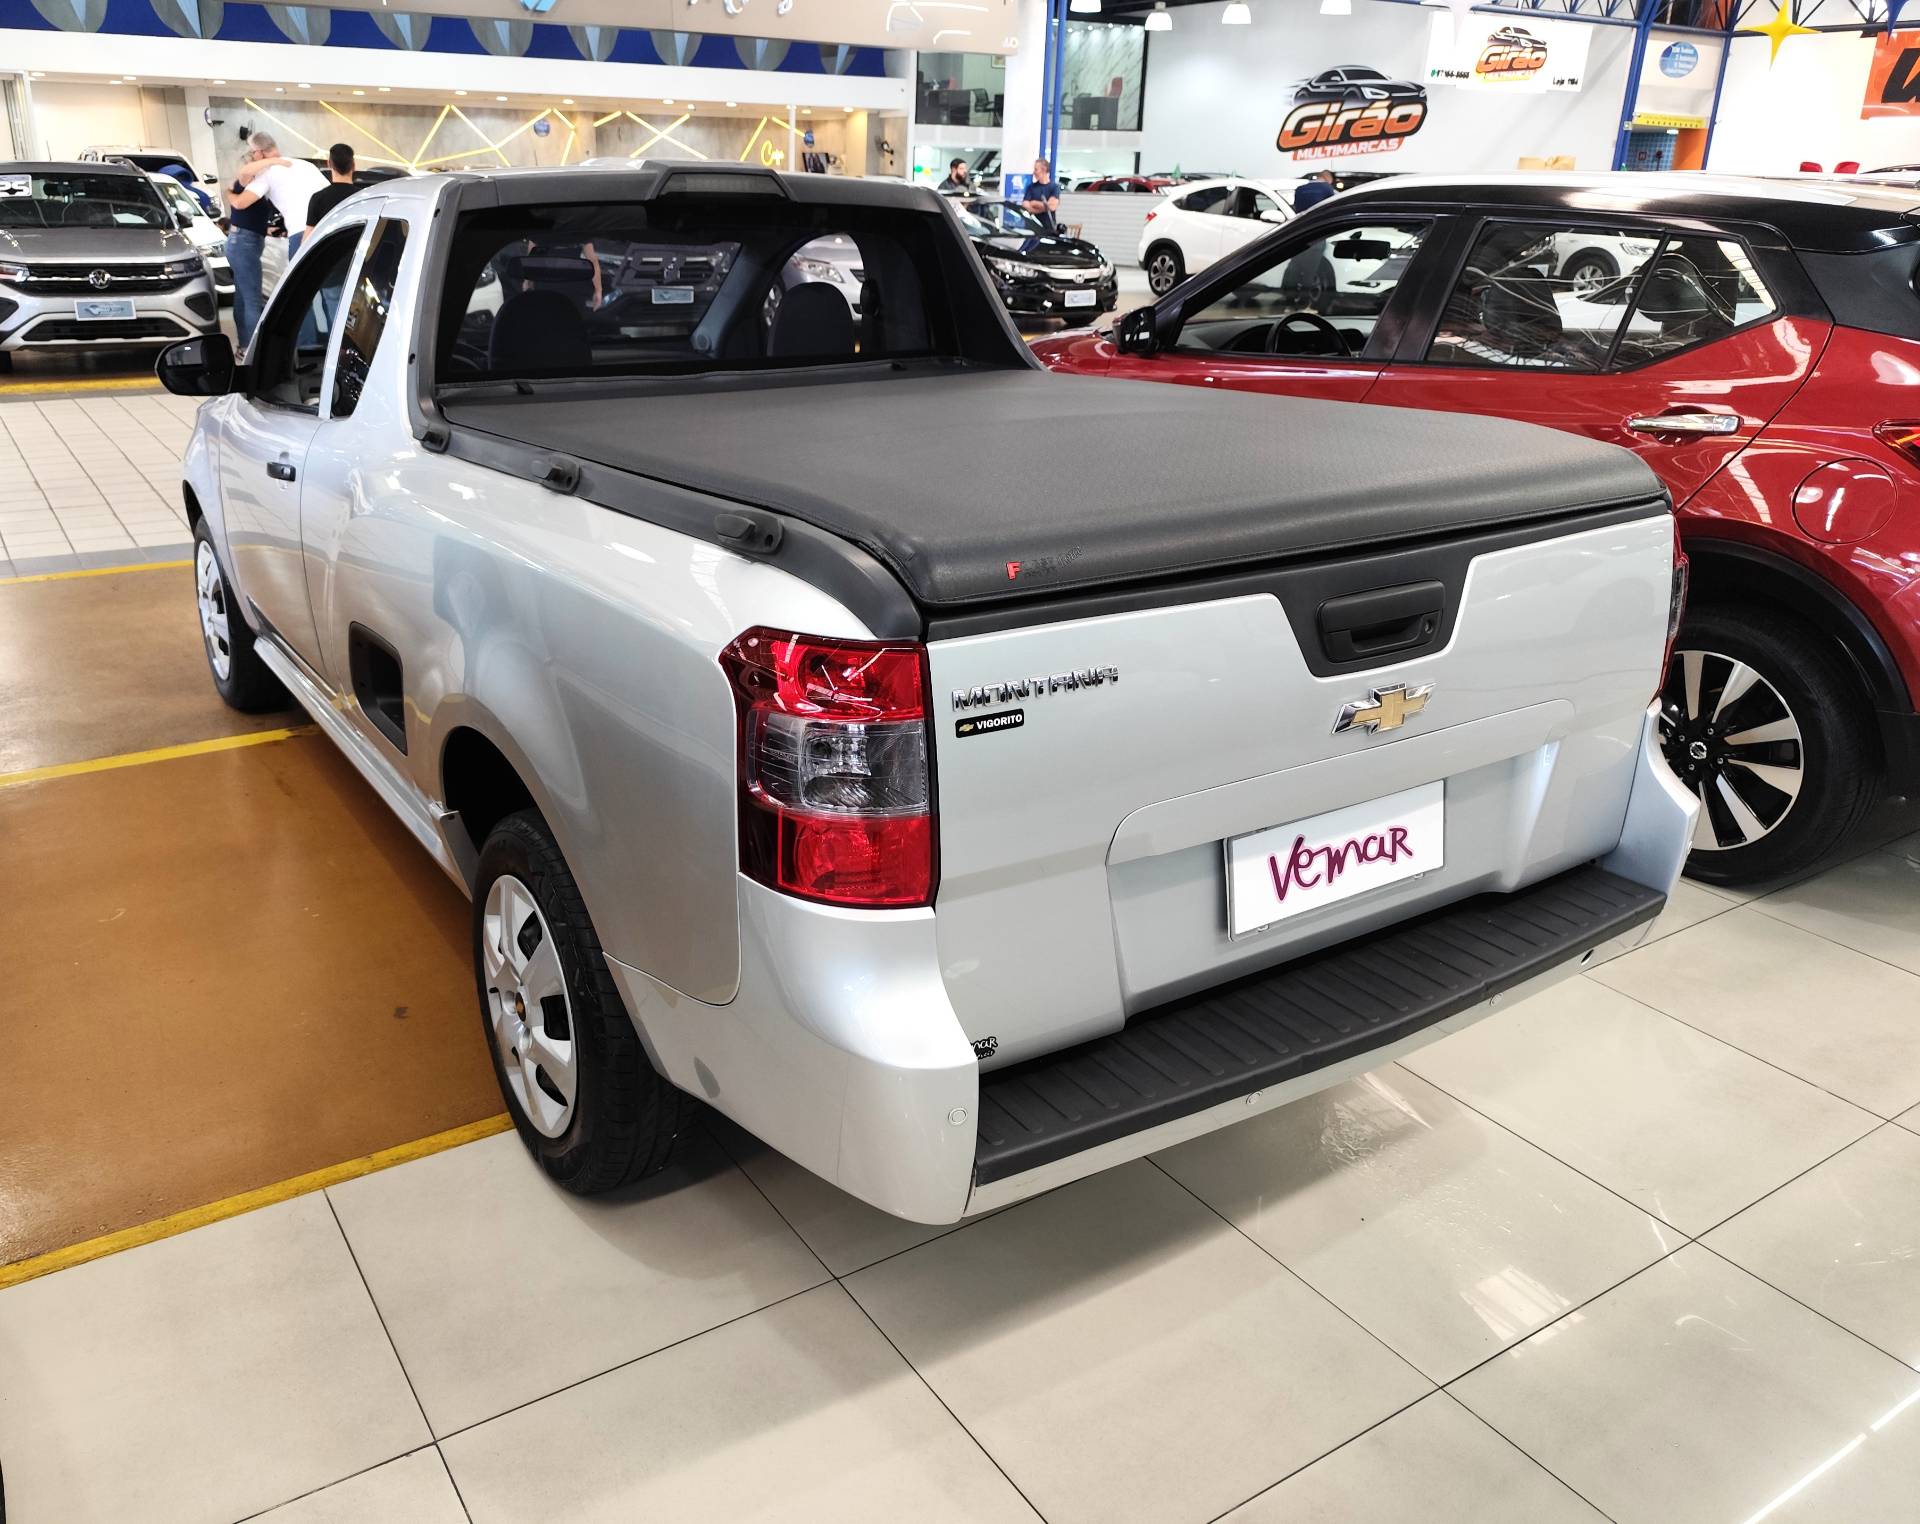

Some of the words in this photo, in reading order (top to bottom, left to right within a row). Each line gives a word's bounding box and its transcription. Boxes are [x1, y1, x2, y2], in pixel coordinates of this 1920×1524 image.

[1296, 139, 1400, 160] MULTIMARCAS
[952, 664, 1119, 712] MONTANA
[976, 713, 1023, 730] VIGORITO
